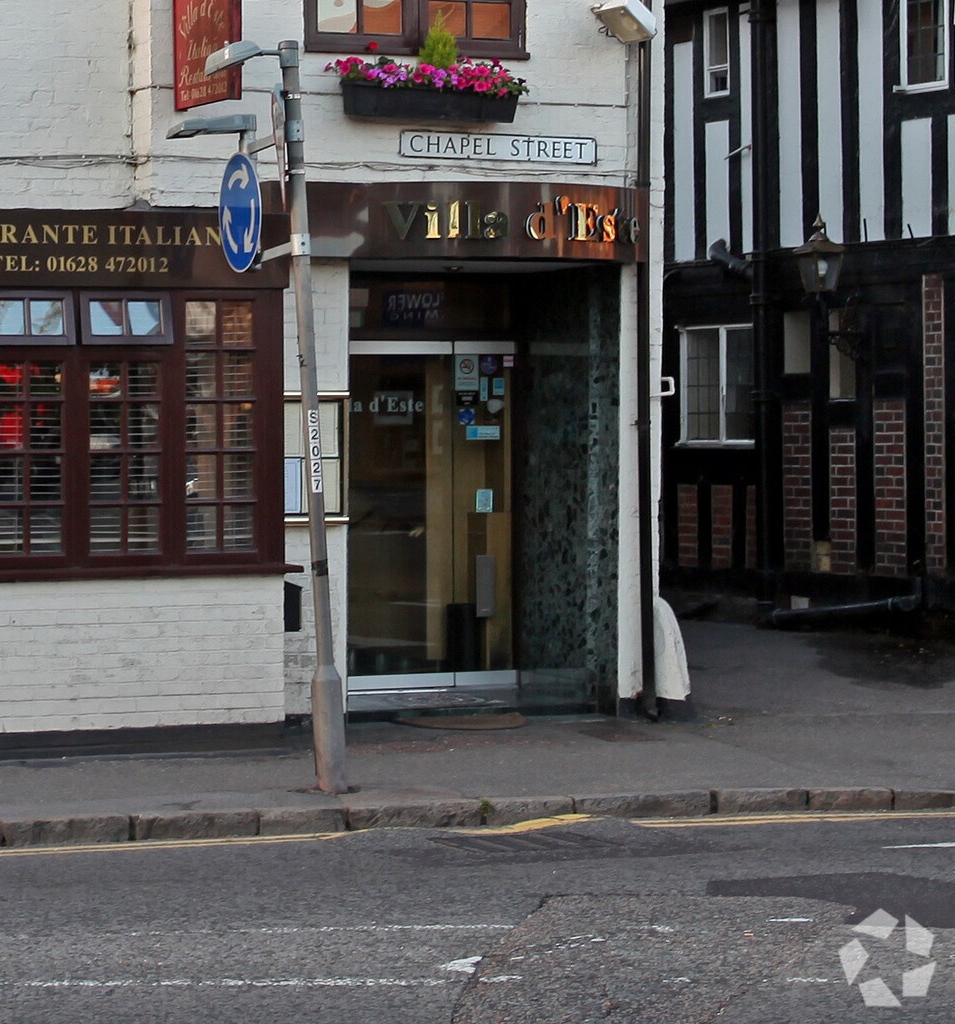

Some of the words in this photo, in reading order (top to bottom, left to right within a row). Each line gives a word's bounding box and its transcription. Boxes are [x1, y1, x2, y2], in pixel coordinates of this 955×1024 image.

[410, 135, 496, 156] CHAPEL
[510, 139, 587, 160] STREET
[383, 200, 509, 240] Villa
[107, 225, 221, 246] ITALIAN
[46, 256, 98, 273] 01628
[104, 257, 170, 273] 472012
[369, 395, 424, 413] d'Este
